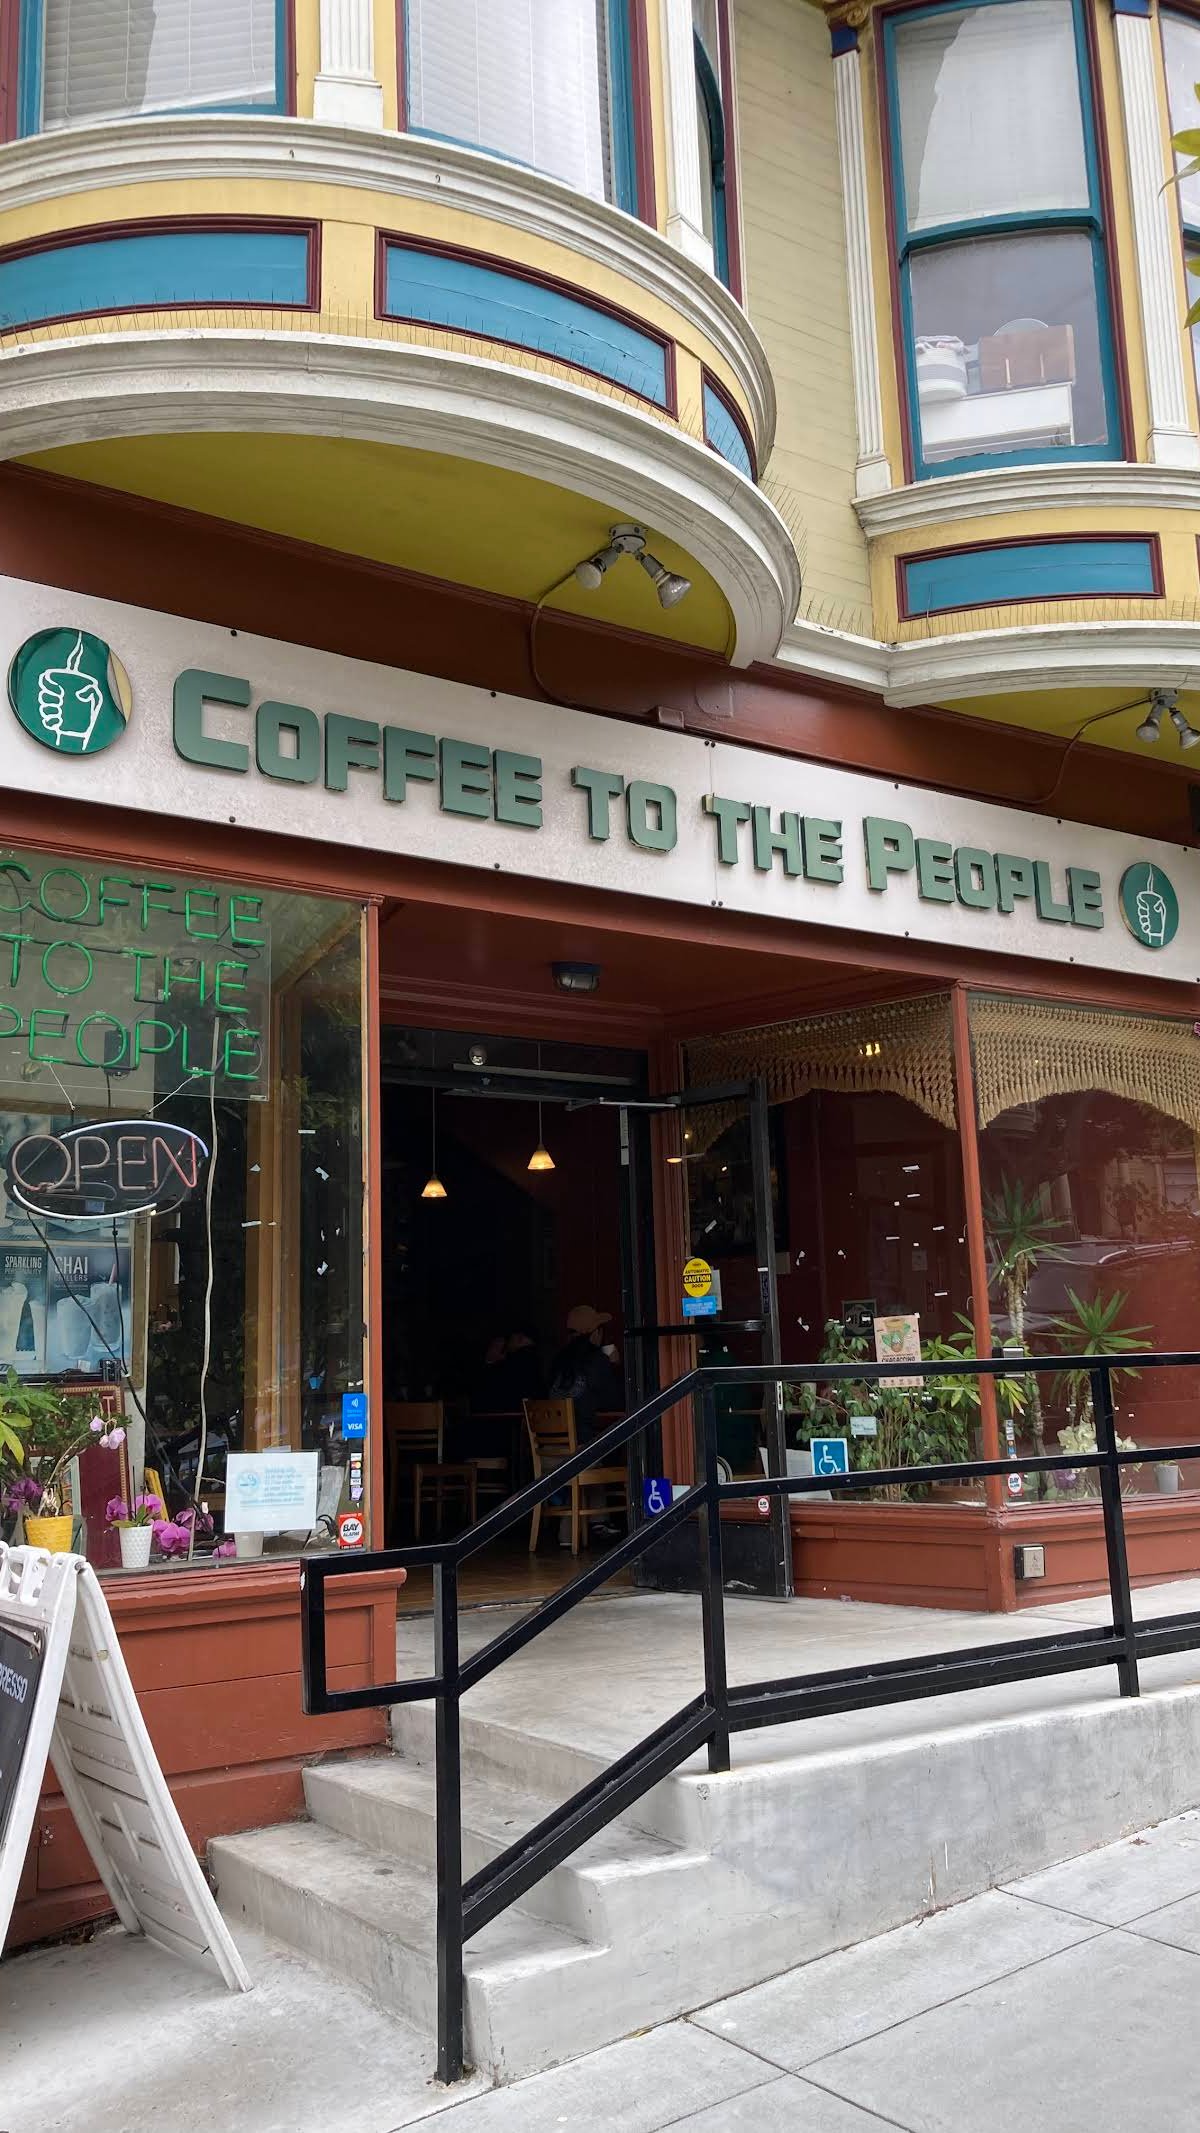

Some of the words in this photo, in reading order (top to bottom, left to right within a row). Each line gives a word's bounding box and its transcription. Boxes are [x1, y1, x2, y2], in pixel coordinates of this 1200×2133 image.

[172, 668, 543, 829] COFFEE
[571, 766, 677, 852] TO
[702, 793, 844, 884] THE
[863, 816, 1104, 929] PEOPLE
[0, 933, 94, 995] TO
[121, 946, 250, 1014] THE
[11, 1134, 198, 1191] OPEN
[5, 1255, 42, 1269] SPARKLING
[55, 1256, 88, 1274] CHAI
[684, 1274, 711, 1283] CAUTION
[347, 1423, 363, 1431] VISA
[342, 1523, 360, 1532] BAY
